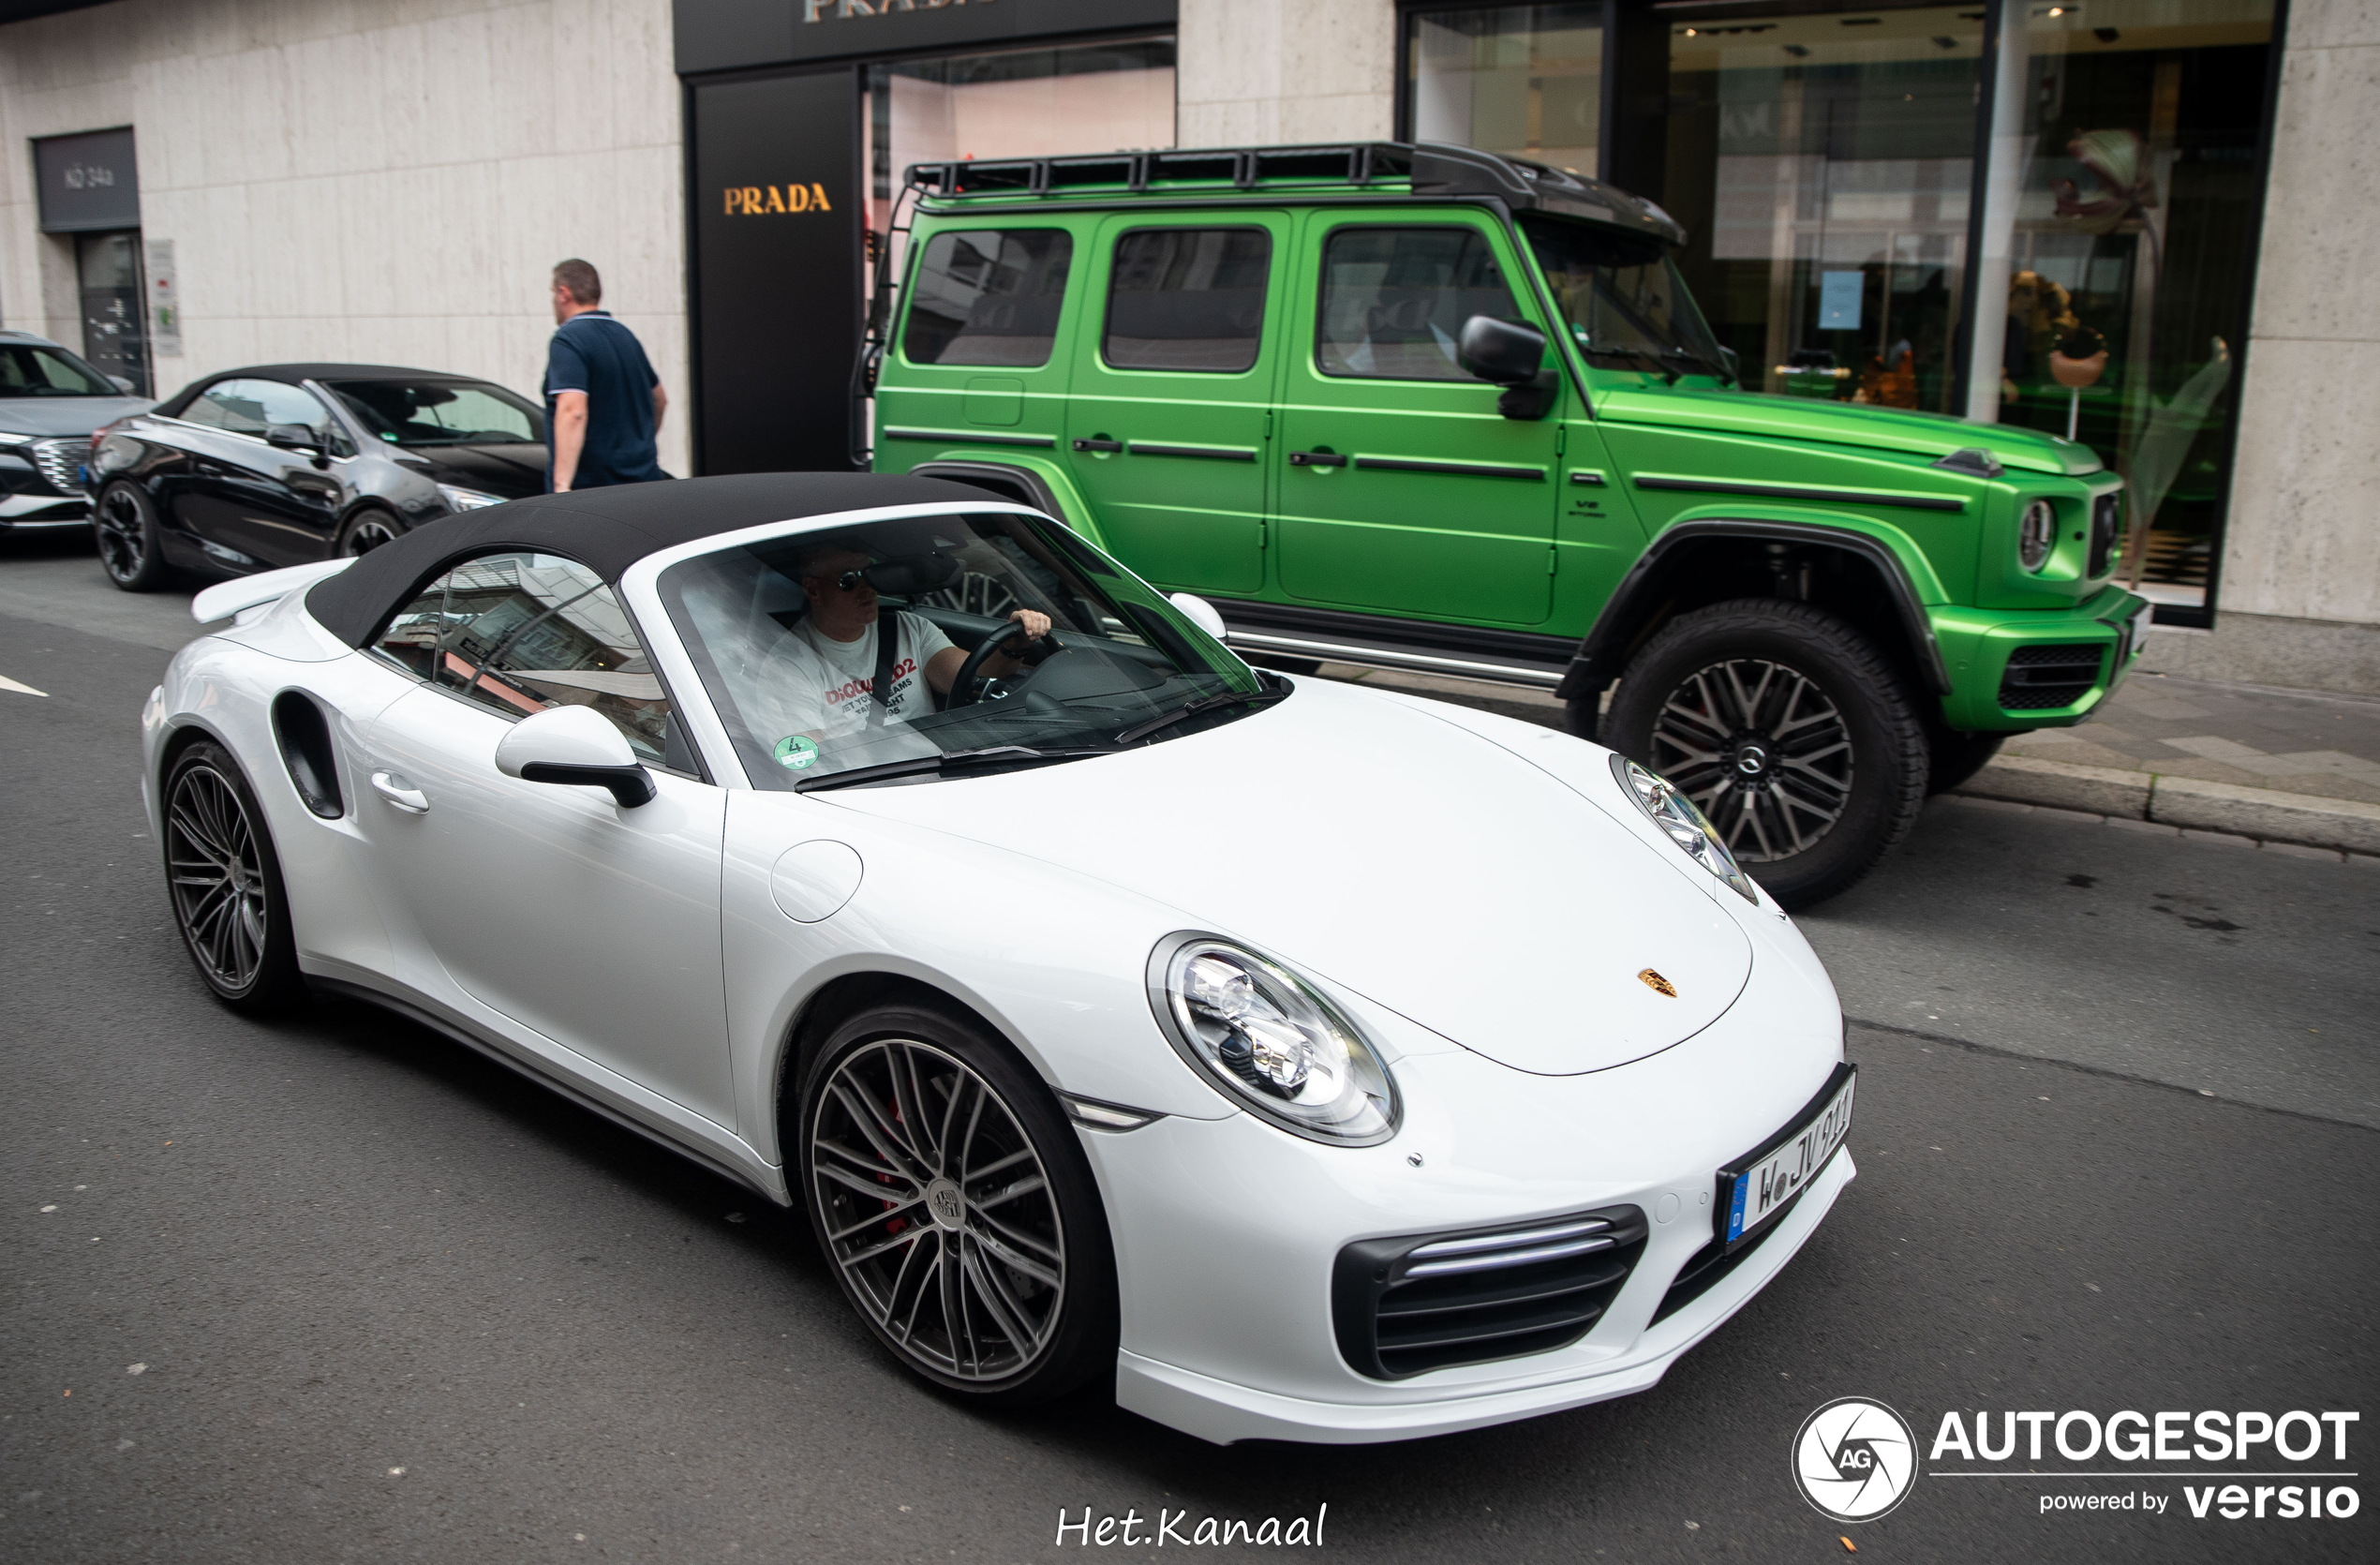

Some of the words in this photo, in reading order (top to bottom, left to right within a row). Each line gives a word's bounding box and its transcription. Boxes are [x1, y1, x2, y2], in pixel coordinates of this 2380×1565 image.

[723, 182, 832, 215] PRADA
[855, 693, 872, 706] YOU
[789, 738, 801, 752] 4
[1758, 1157, 1779, 1214] W
[1789, 1121, 1822, 1187] JV
[1820, 1086, 1849, 1157] 911
